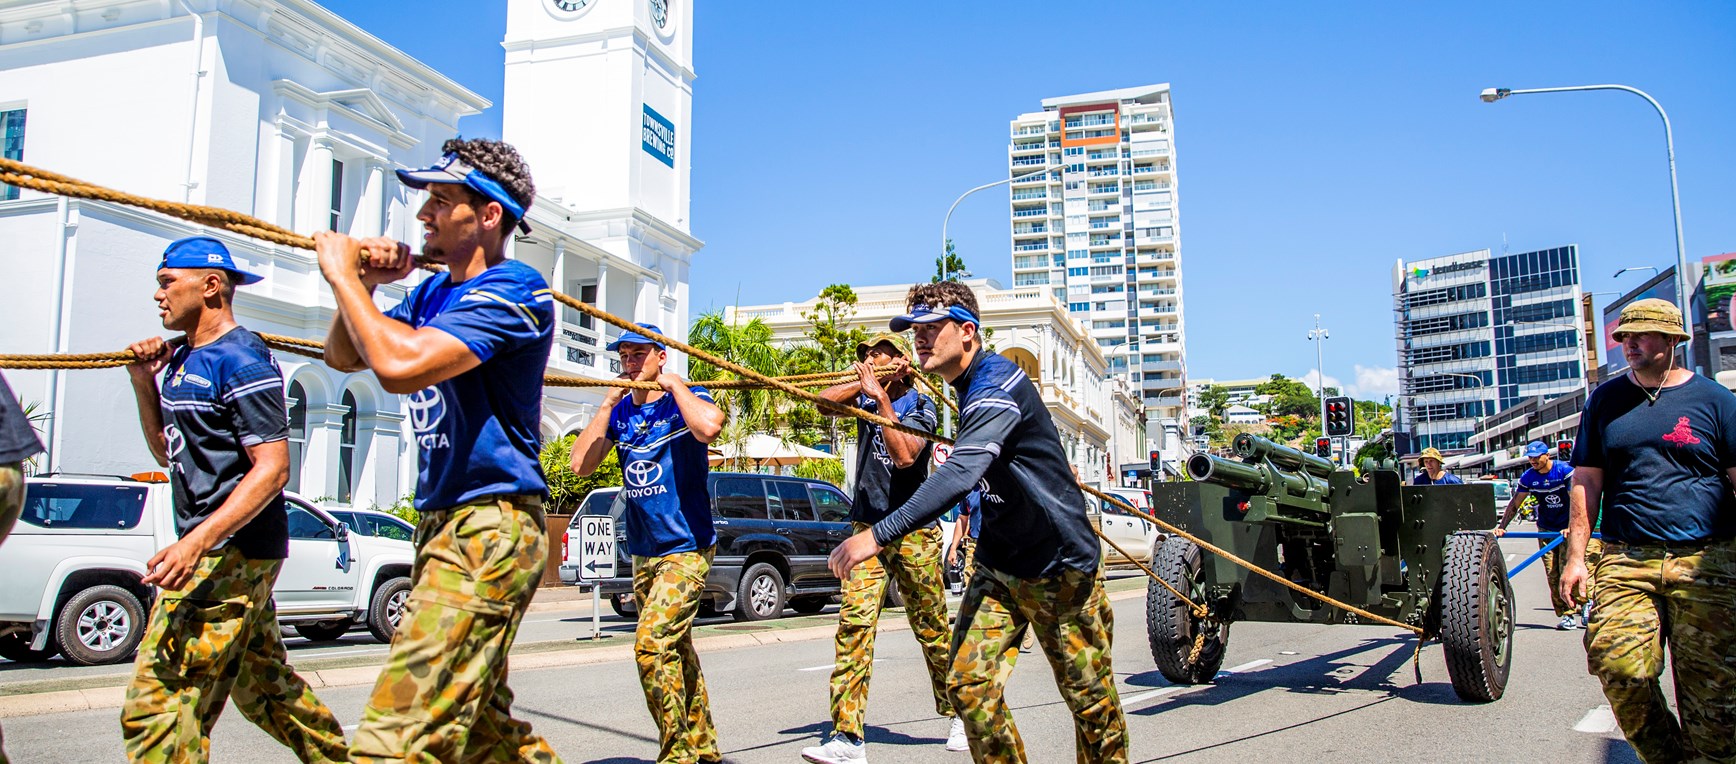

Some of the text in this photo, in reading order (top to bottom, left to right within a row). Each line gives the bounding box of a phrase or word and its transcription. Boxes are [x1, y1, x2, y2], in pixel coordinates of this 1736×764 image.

[643, 112, 674, 146] TOWNSVILLE
[643, 127, 667, 155] BREWING
[1432, 260, 1484, 275] lendlease
[627, 485, 667, 499] TOYOTA
[587, 522, 611, 536] ONE
[585, 541, 613, 555] WAY
